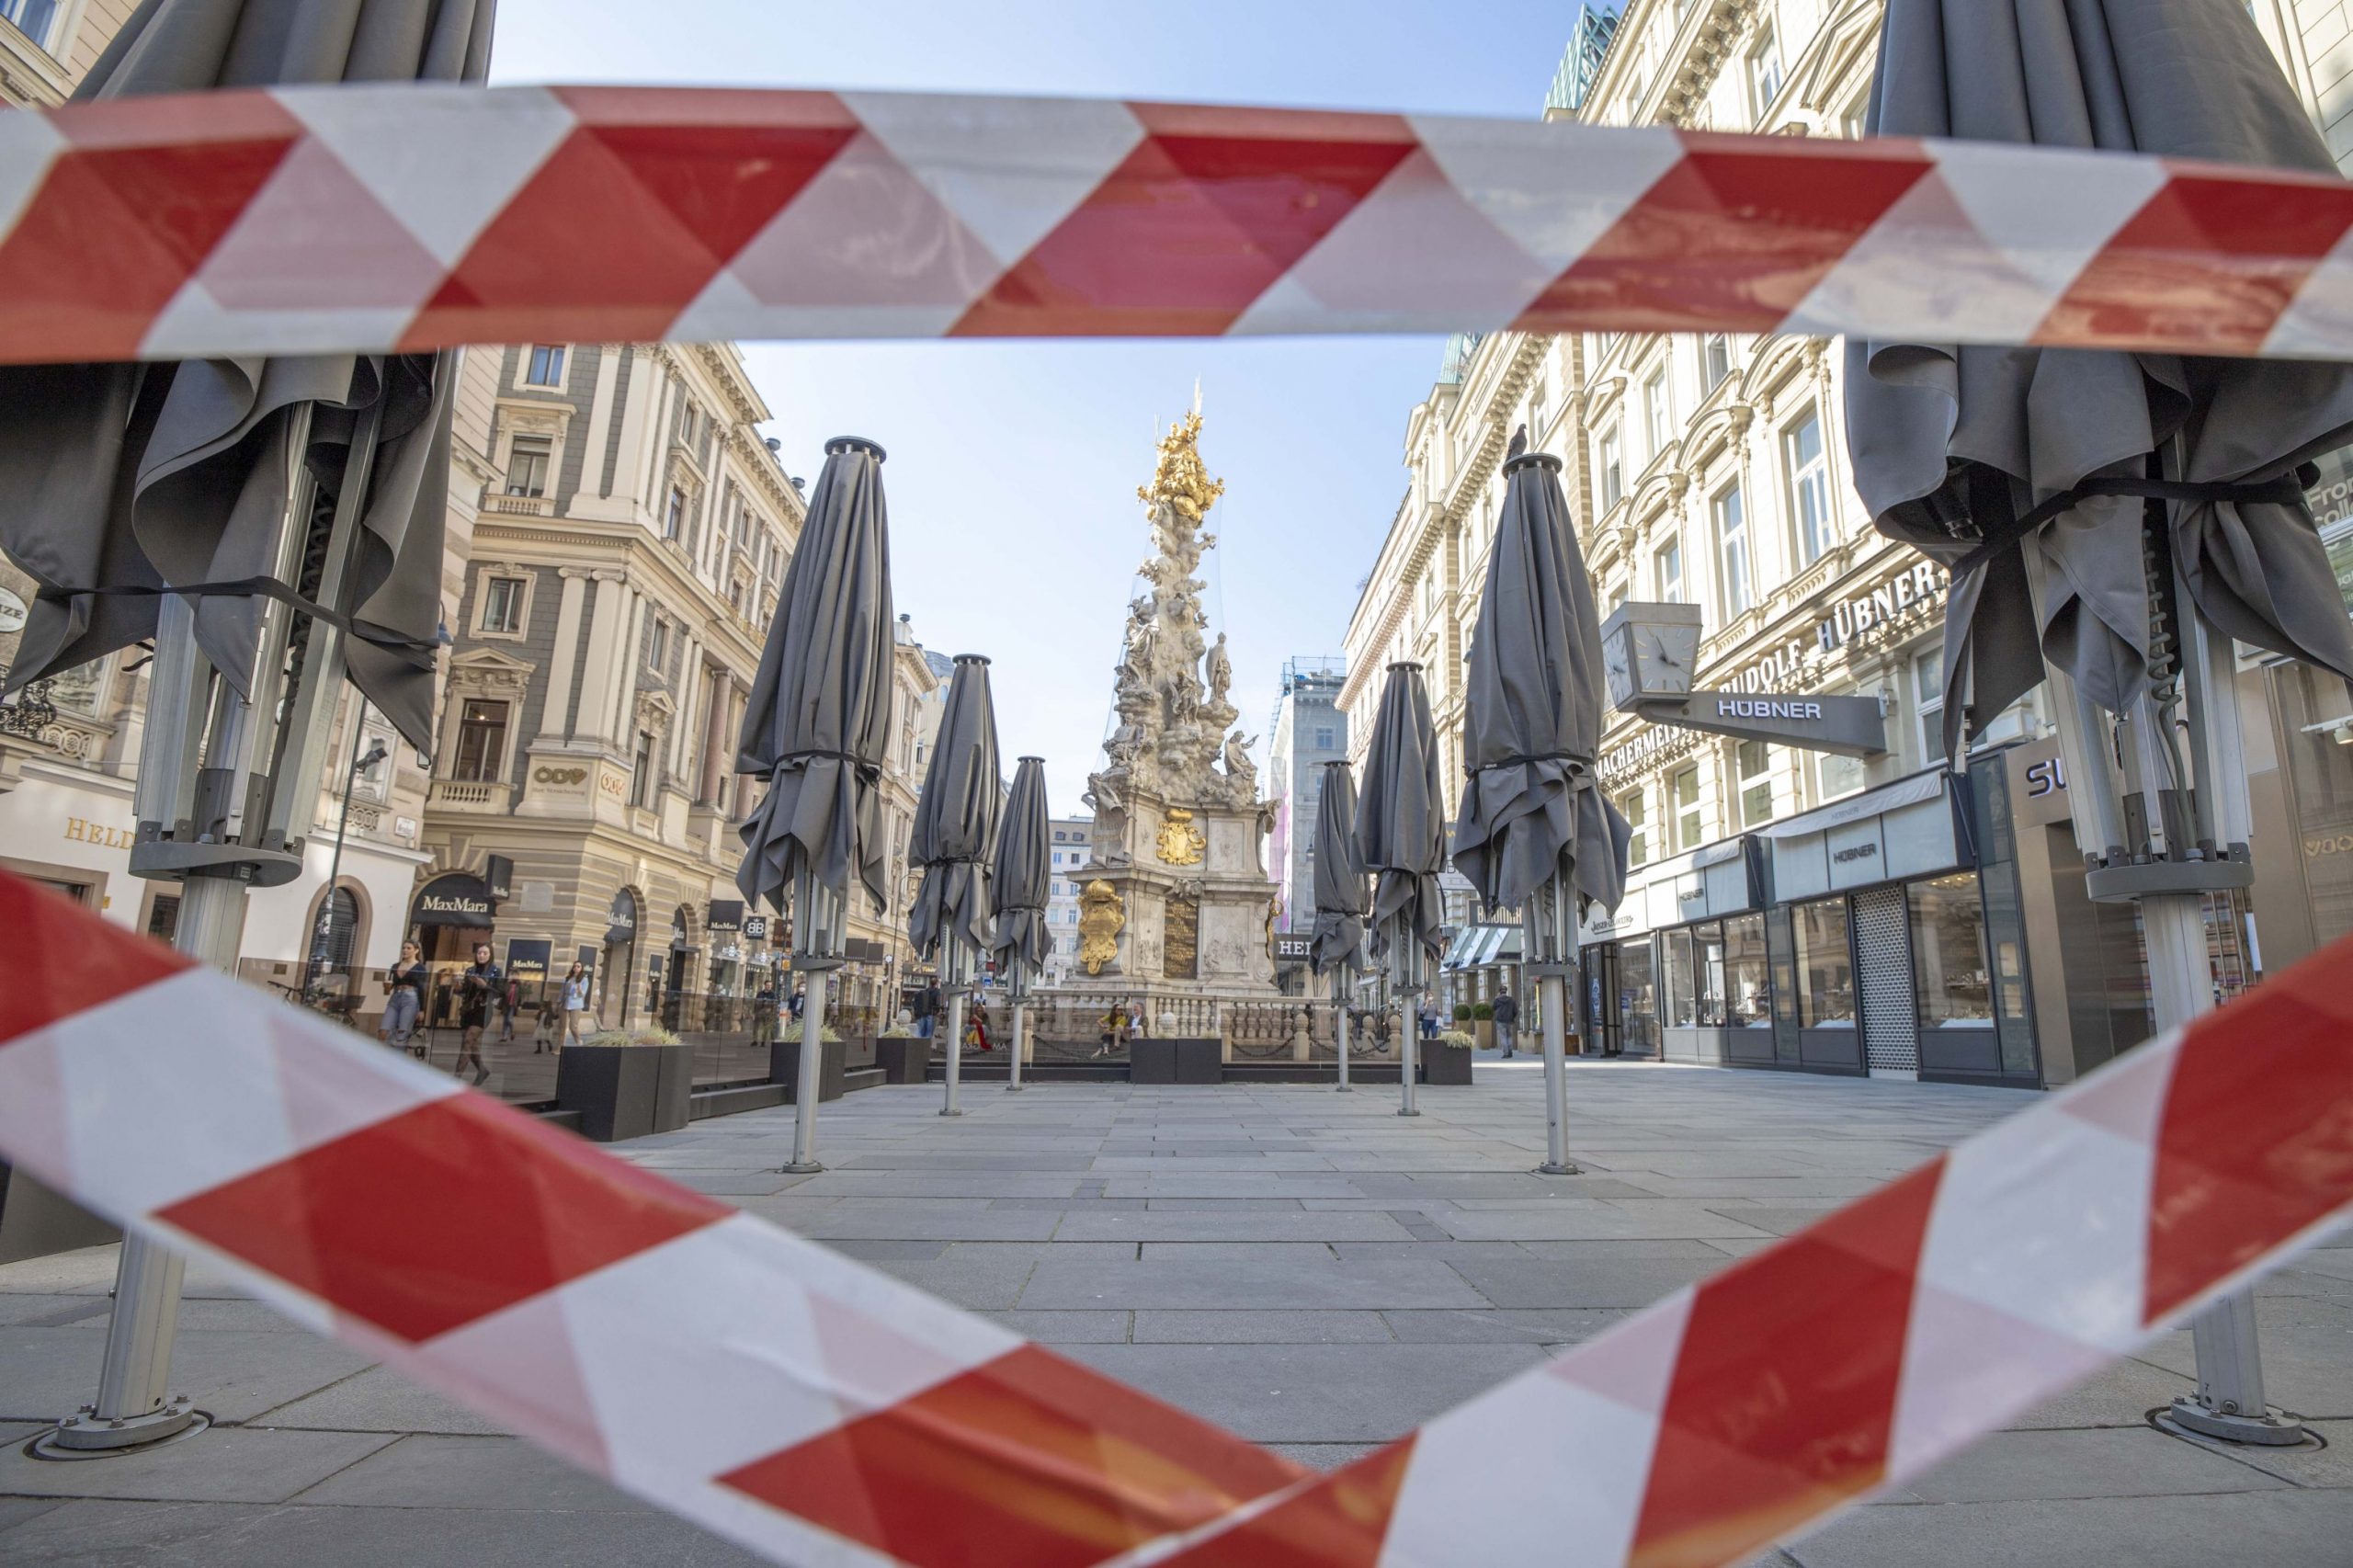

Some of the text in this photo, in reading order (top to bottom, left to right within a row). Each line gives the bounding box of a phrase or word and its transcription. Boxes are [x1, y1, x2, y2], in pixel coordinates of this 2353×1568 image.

[1815, 559, 1938, 654] HÜBNER
[1717, 699, 1822, 720] HÜBNER
[422, 895, 488, 913] MaxMara
[710, 922, 737, 930] MaxMara
